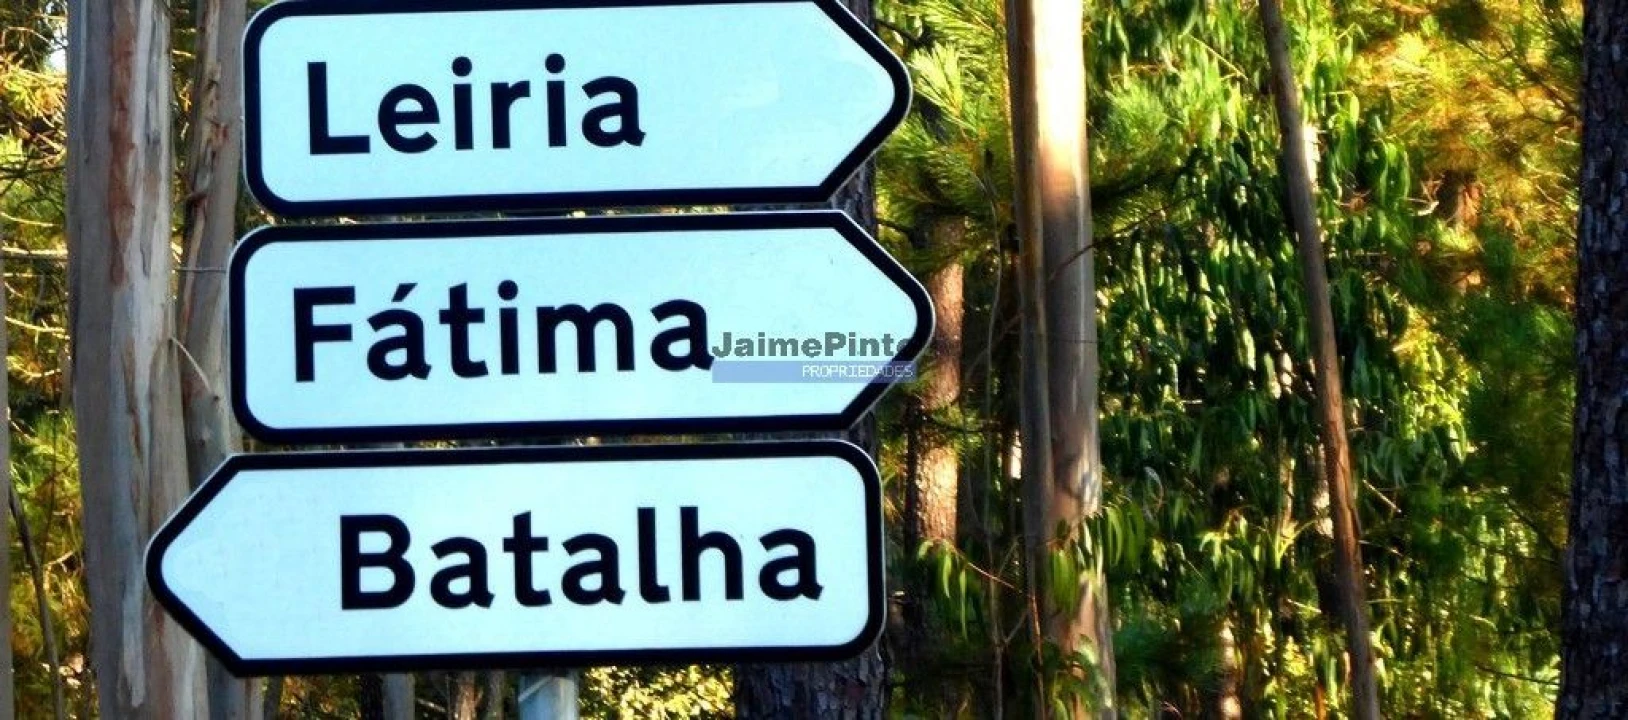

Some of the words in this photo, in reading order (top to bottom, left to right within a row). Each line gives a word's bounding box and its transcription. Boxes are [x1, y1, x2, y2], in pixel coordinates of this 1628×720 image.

[307, 53, 646, 155] Leiria
[293, 279, 715, 383] Fátima
[339, 506, 823, 611] Batalha
